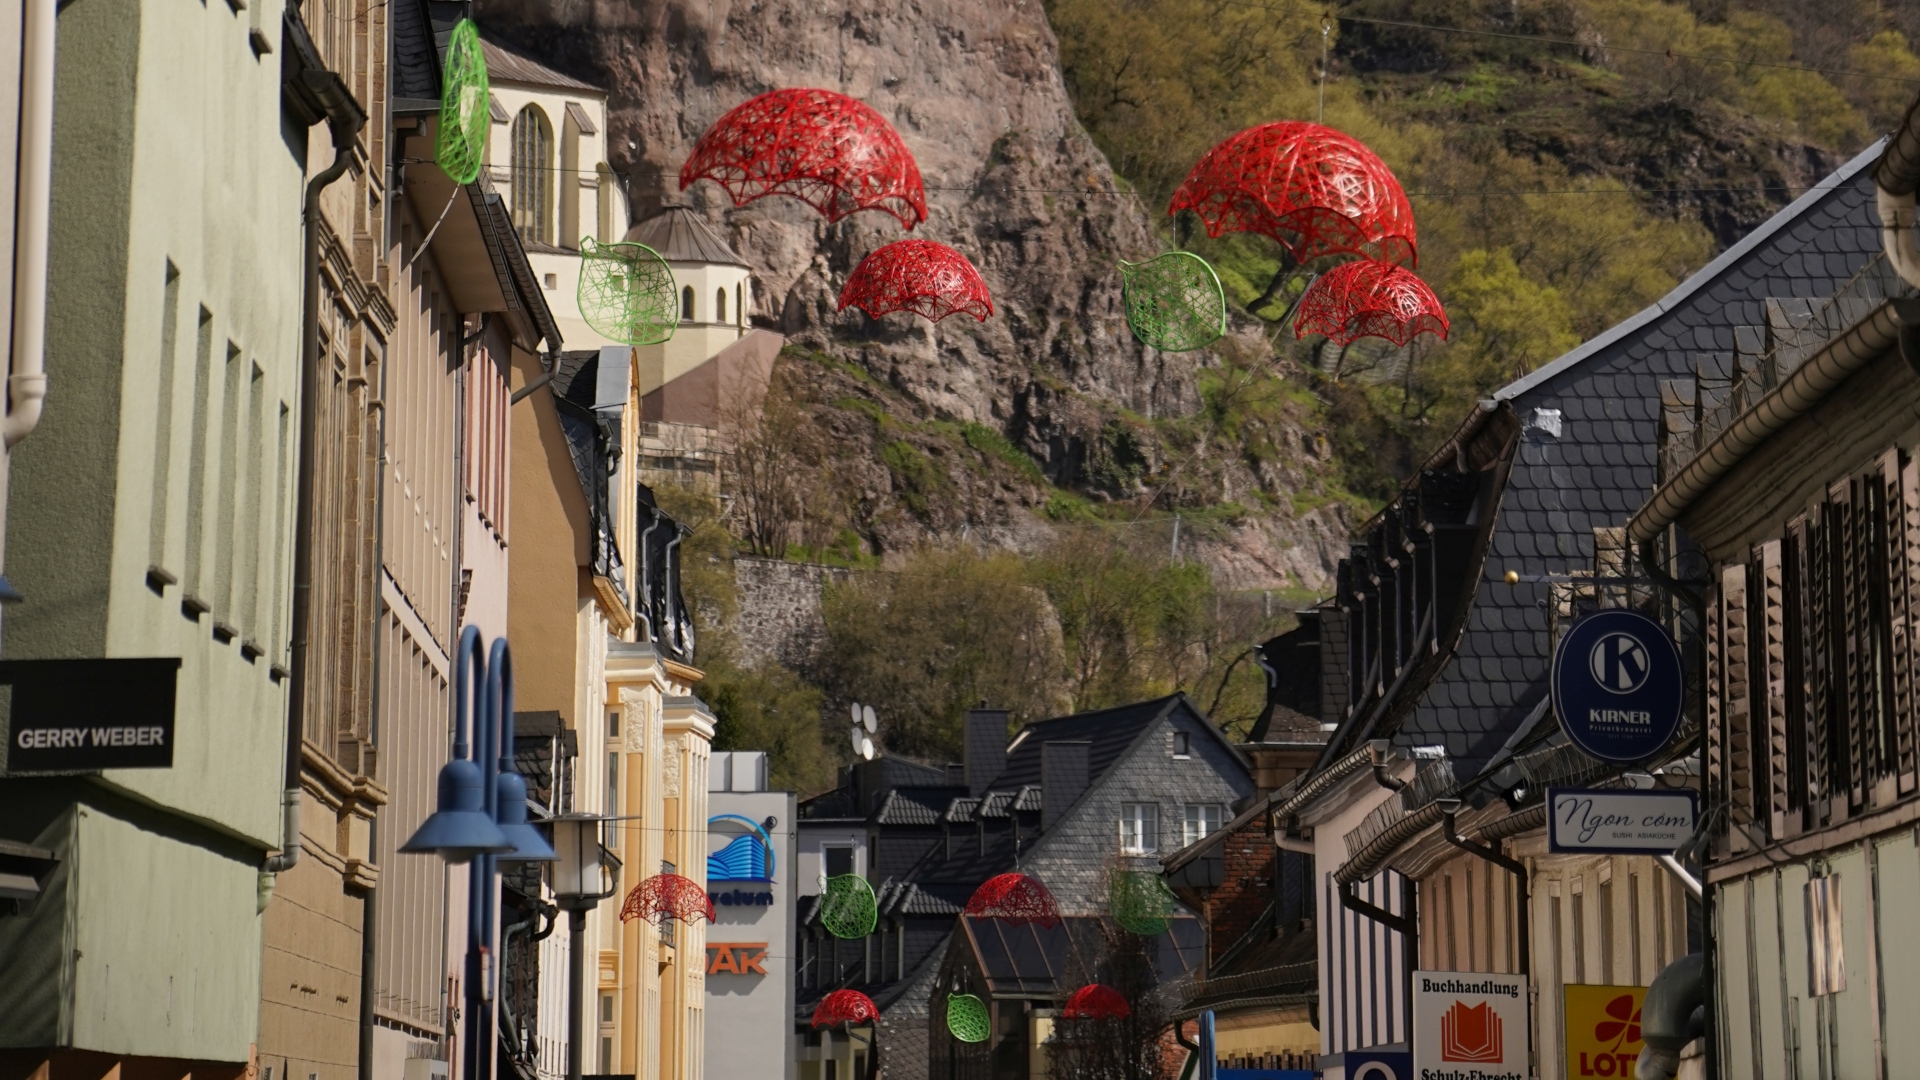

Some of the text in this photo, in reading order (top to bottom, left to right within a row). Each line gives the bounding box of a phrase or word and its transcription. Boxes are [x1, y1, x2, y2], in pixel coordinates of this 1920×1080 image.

[1589, 708, 1651, 724] KIRNER
[17, 726, 164, 748] GERRY WEBER
[1589, 725, 1652, 733] Privatbrauerei
[1557, 798, 1634, 843] Ngon
[1637, 832, 1676, 840] ASIAKÜCHE
[706, 942, 770, 974] AK
[1422, 978, 1519, 998] Buchhandlung
[1579, 1052, 1639, 1078] LOT
